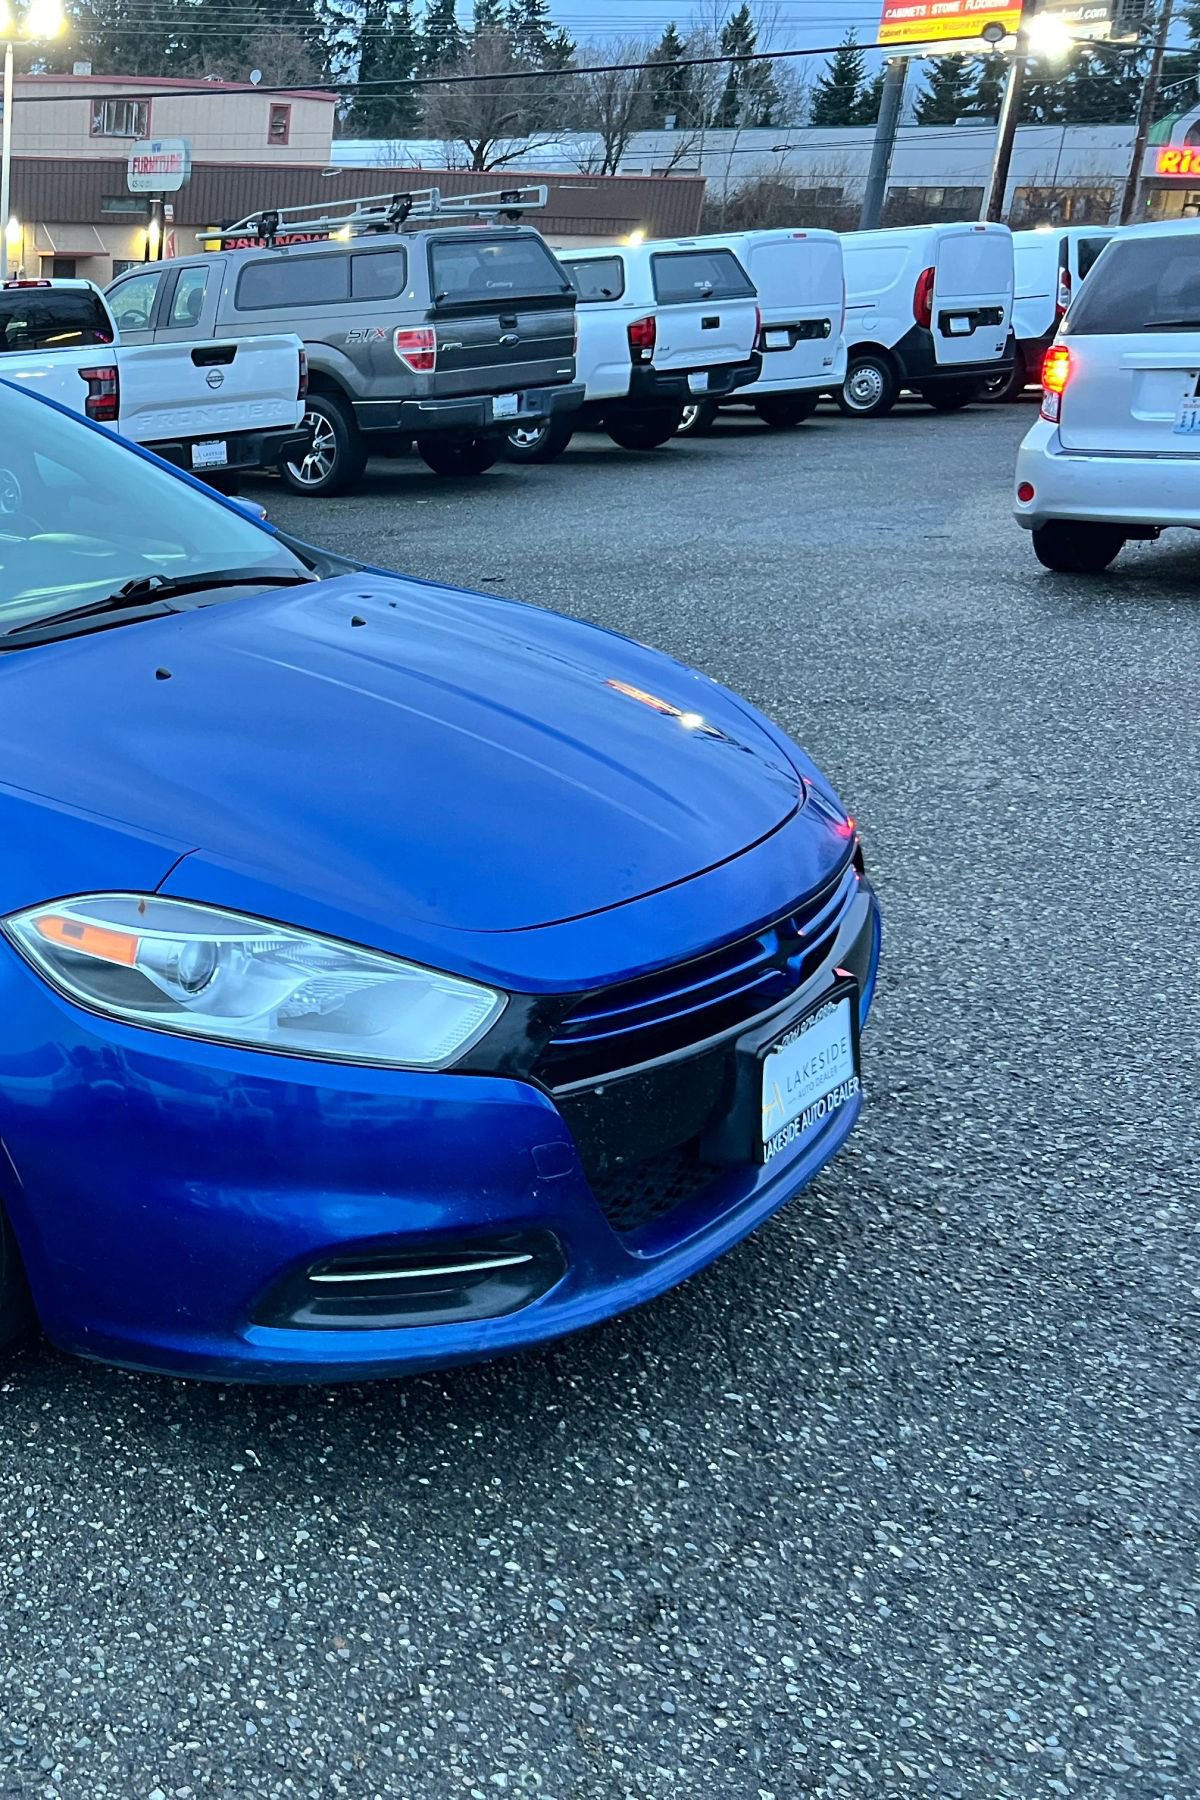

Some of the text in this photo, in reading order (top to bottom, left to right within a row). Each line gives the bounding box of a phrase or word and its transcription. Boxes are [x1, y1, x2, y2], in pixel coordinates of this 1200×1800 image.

[885, 4, 927, 19] CABINETS
[931, 1, 960, 15] STONE
[132, 153, 183, 175] FURNITURE
[348, 327, 386, 340] STX
[136, 401, 283, 431] FRONTIER
[786, 1036, 848, 1093] LAKESIDE
[797, 1064, 838, 1099] AUTO DEALER
[763, 1076, 861, 1164] LAKESIDE AUTO DEALER
